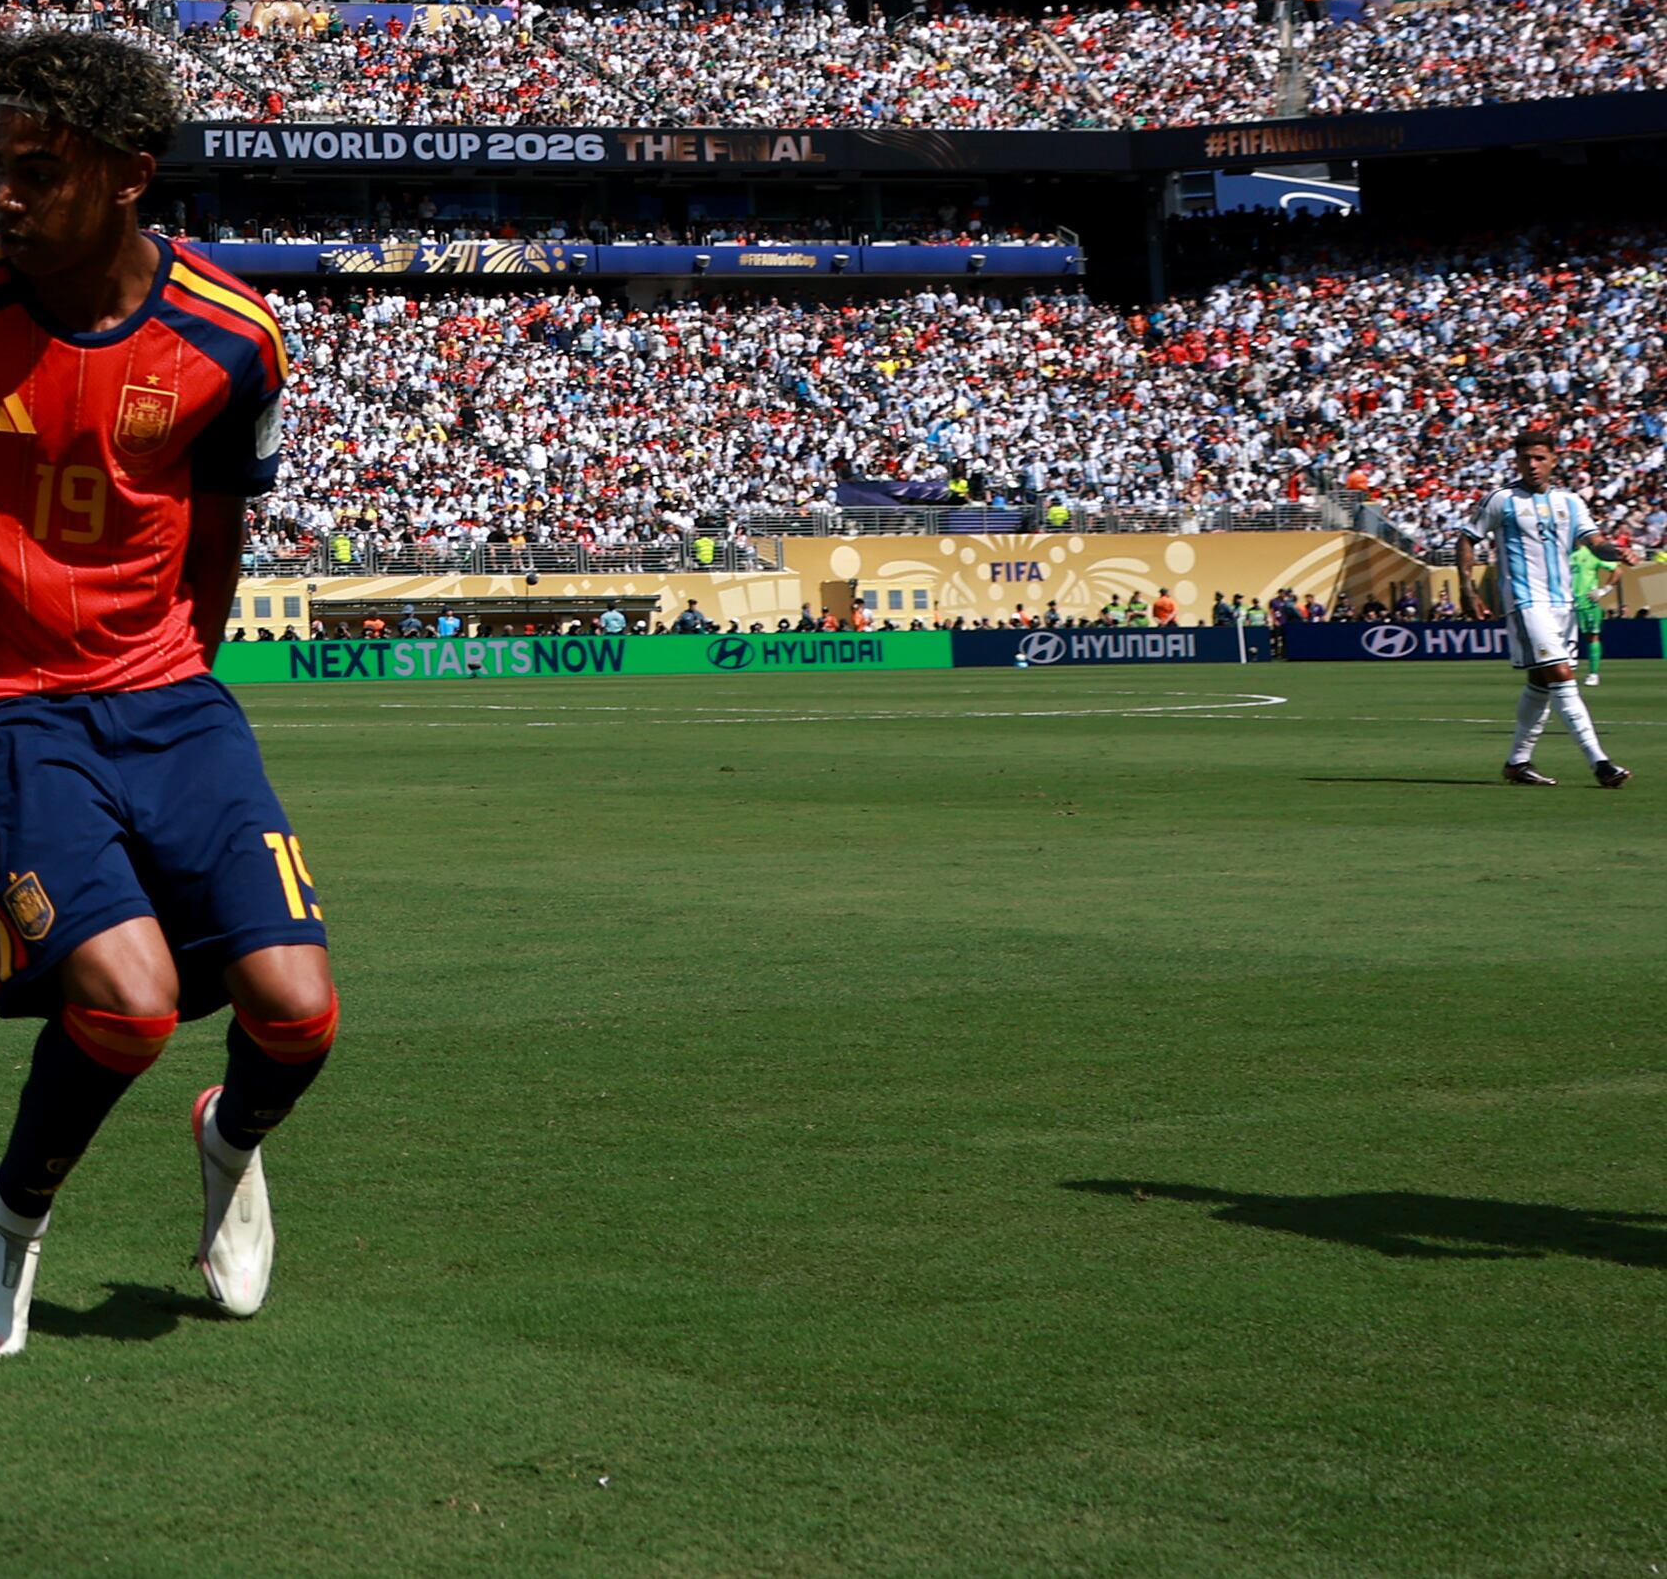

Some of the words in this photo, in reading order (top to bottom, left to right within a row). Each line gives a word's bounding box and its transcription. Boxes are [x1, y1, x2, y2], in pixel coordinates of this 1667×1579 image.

[204, 129, 271, 158] FIFA
[283, 131, 404, 160] WORLD
[413, 132, 482, 160] CUP
[487, 133, 605, 162] 2026
[618, 133, 698, 162] THE
[704, 135, 827, 163] FINAL
[33, 463, 107, 544] 19
[990, 560, 1045, 583] FIFA
[763, 638, 883, 665] HYUNDAI
[1072, 632, 1197, 659] HYUNDAI
[1424, 626, 1509, 654] HYUN
